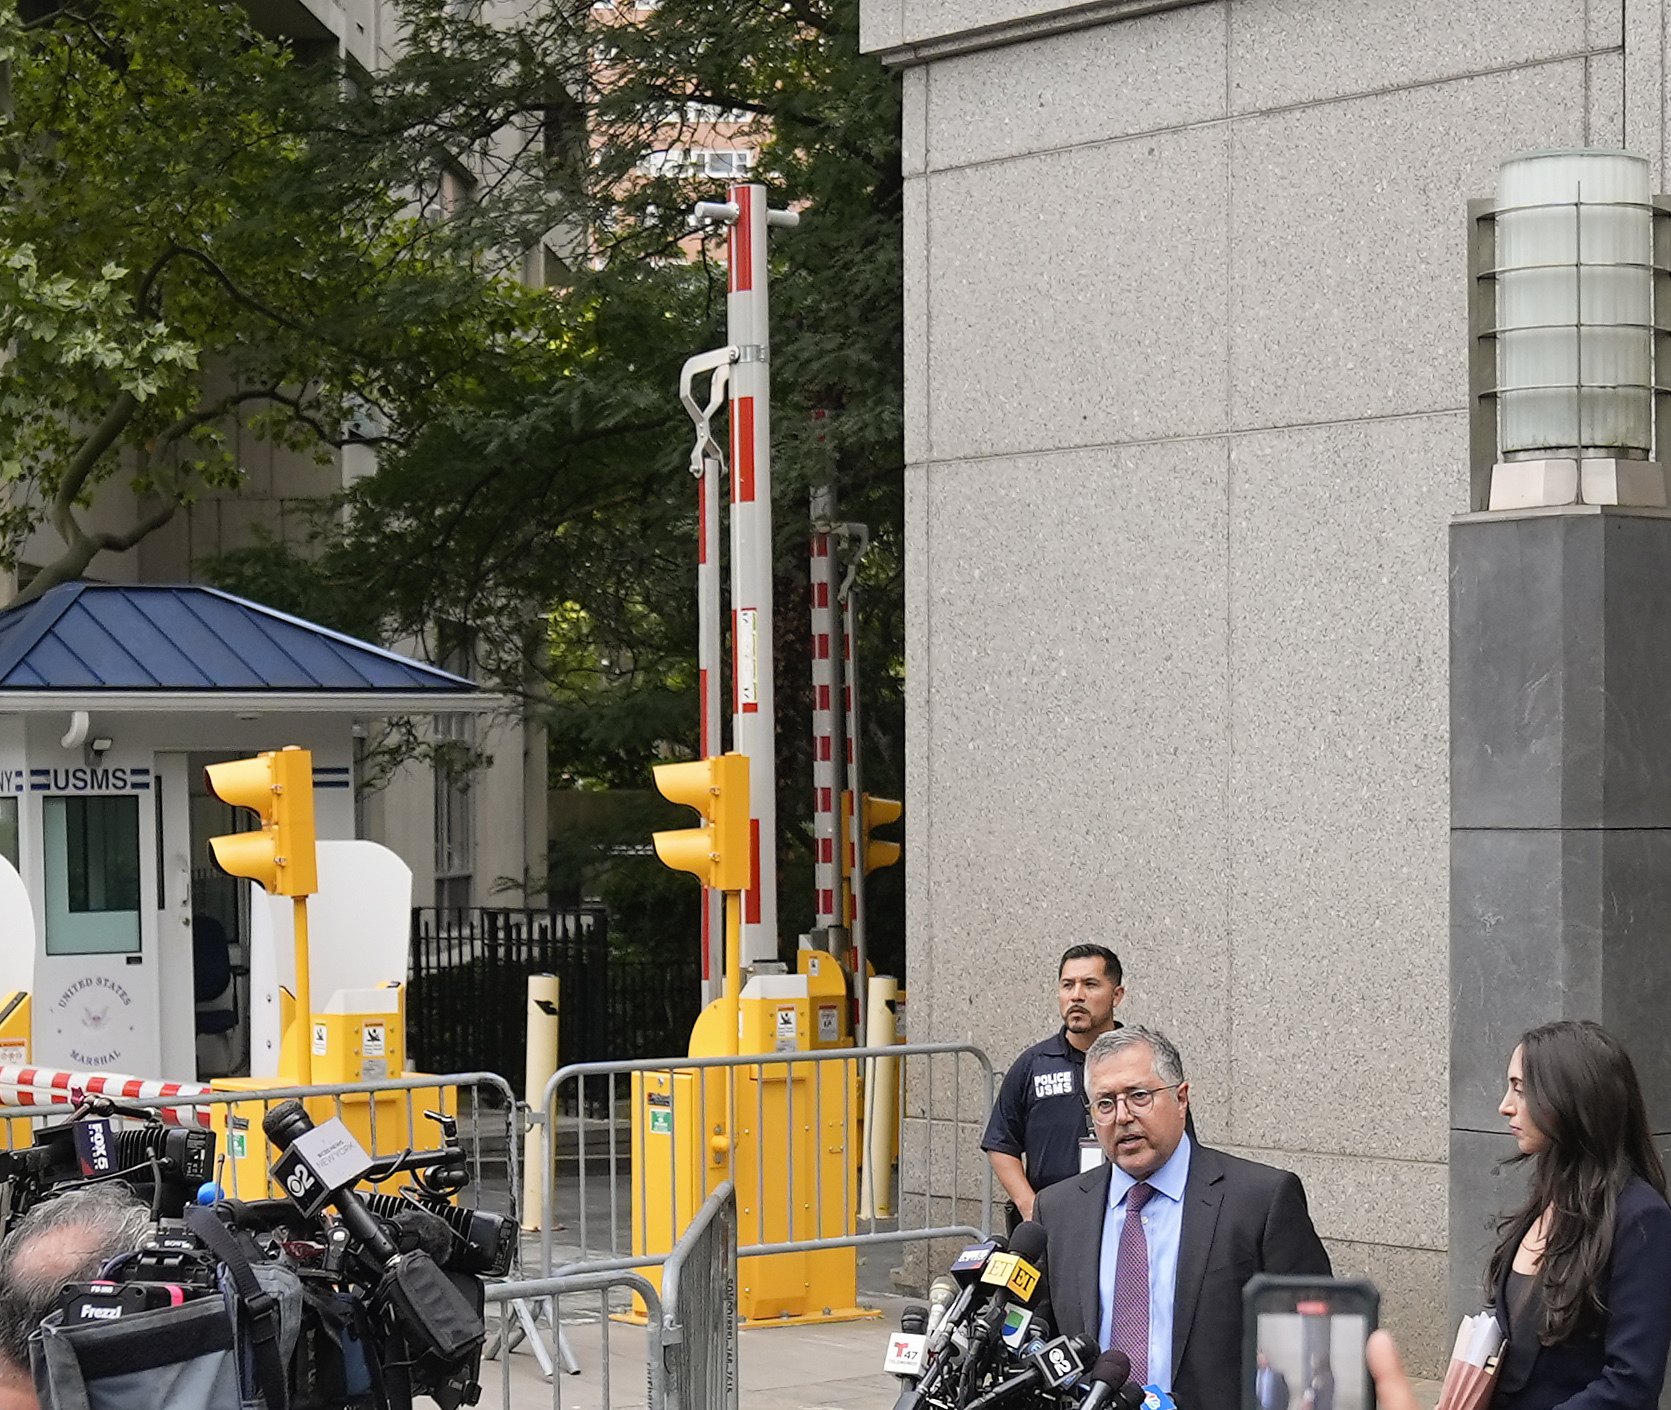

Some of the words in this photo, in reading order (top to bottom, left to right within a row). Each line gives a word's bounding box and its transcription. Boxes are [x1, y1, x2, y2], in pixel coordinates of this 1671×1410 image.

[53, 768, 128, 791] USMS
[58, 977, 93, 1008] UNITED
[95, 976, 131, 1006] STATES
[70, 1049, 121, 1066] MARSHAL
[1034, 1071, 1071, 1087] POLICE
[1035, 1082, 1072, 1098] USMS
[89, 1123, 107, 1158] FOX
[988, 1260, 1013, 1277] ET
[1013, 1267, 1036, 1292] ET
[903, 1351, 918, 1361] 47
